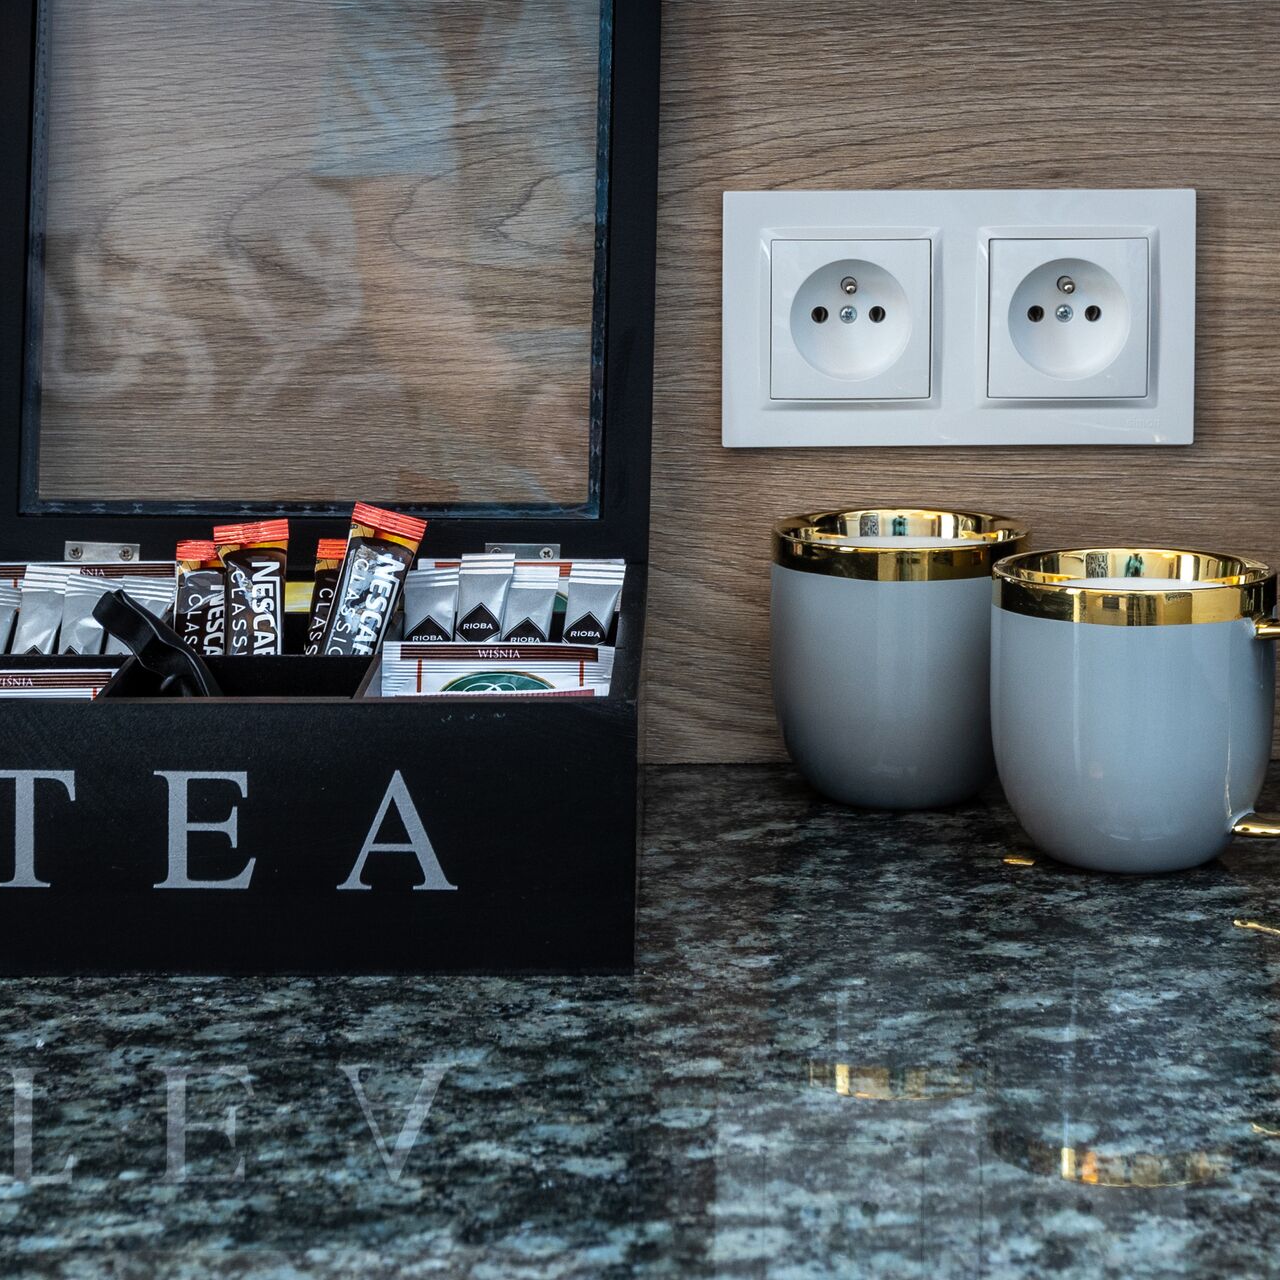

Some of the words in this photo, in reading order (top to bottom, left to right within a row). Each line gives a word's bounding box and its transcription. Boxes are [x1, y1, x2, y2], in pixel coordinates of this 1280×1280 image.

[183, 593, 203, 653] CLAS
[203, 584, 224, 655] NESCA
[251, 561, 282, 655] NESCAF
[305, 587, 333, 655] CLASS
[350, 553, 406, 655] NESCAF
[463, 622, 494, 630] RIOBA
[570, 630, 601, 638] RIOBA
[478, 646, 521, 658] WIŚNIA
